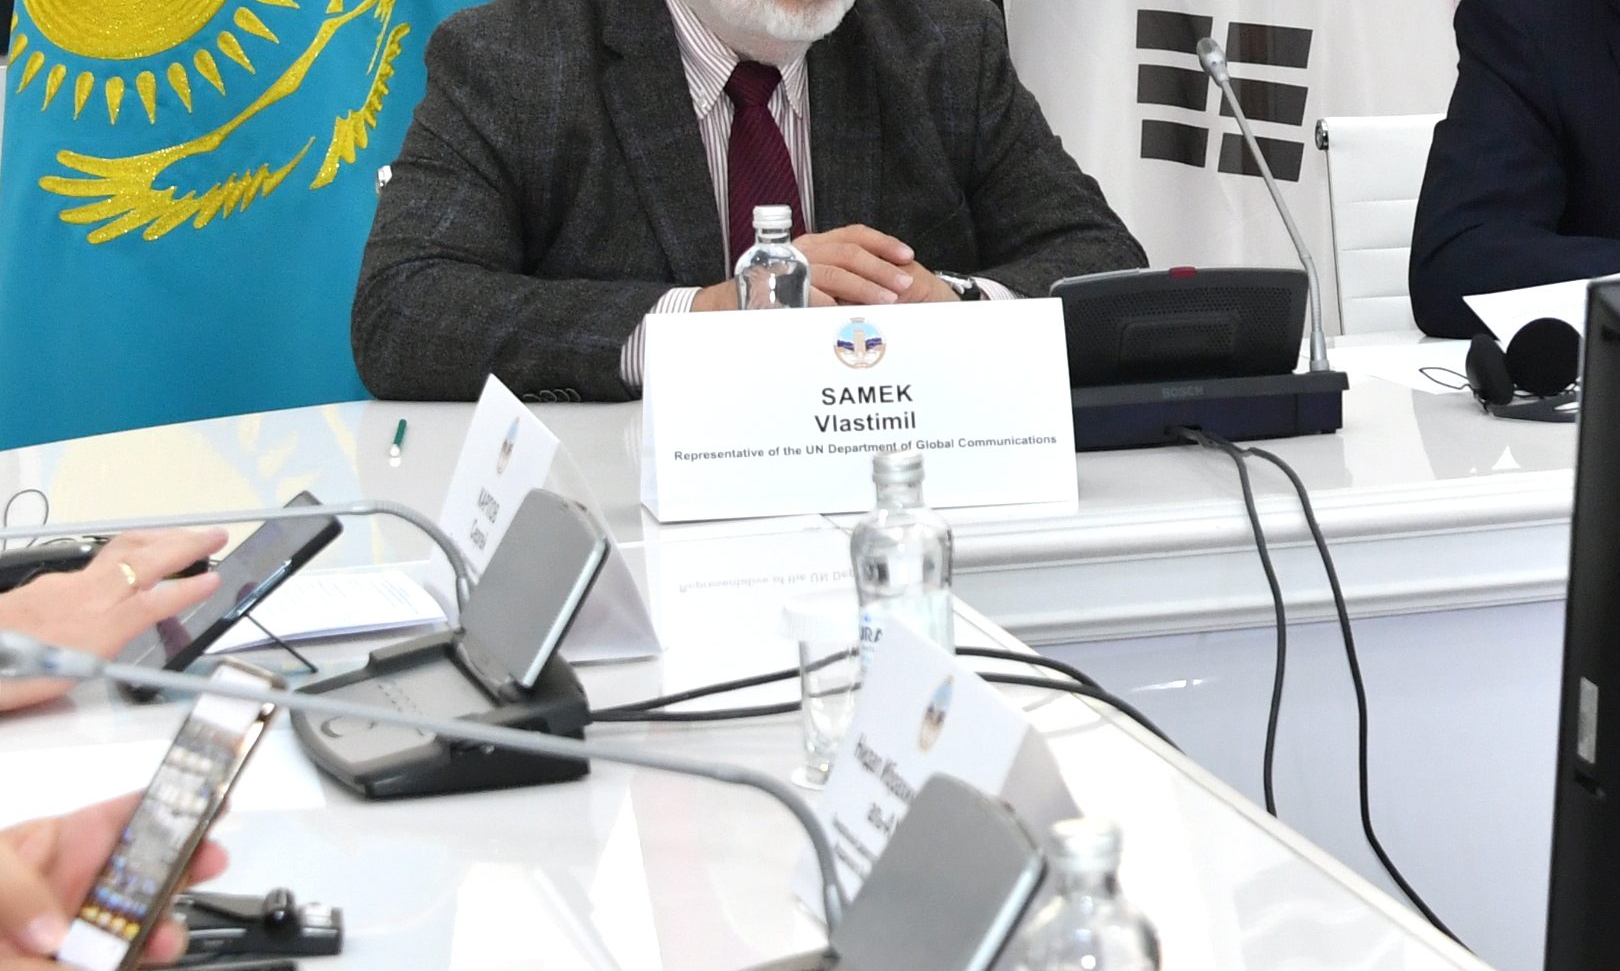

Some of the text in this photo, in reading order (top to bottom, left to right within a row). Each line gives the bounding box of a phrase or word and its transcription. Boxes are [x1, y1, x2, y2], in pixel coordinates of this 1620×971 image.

[821, 384, 913, 406] SAMEK
[814, 411, 917, 433] Vlastimil
[674, 434, 1057, 462] Representative of the UN Department of Global Communications
